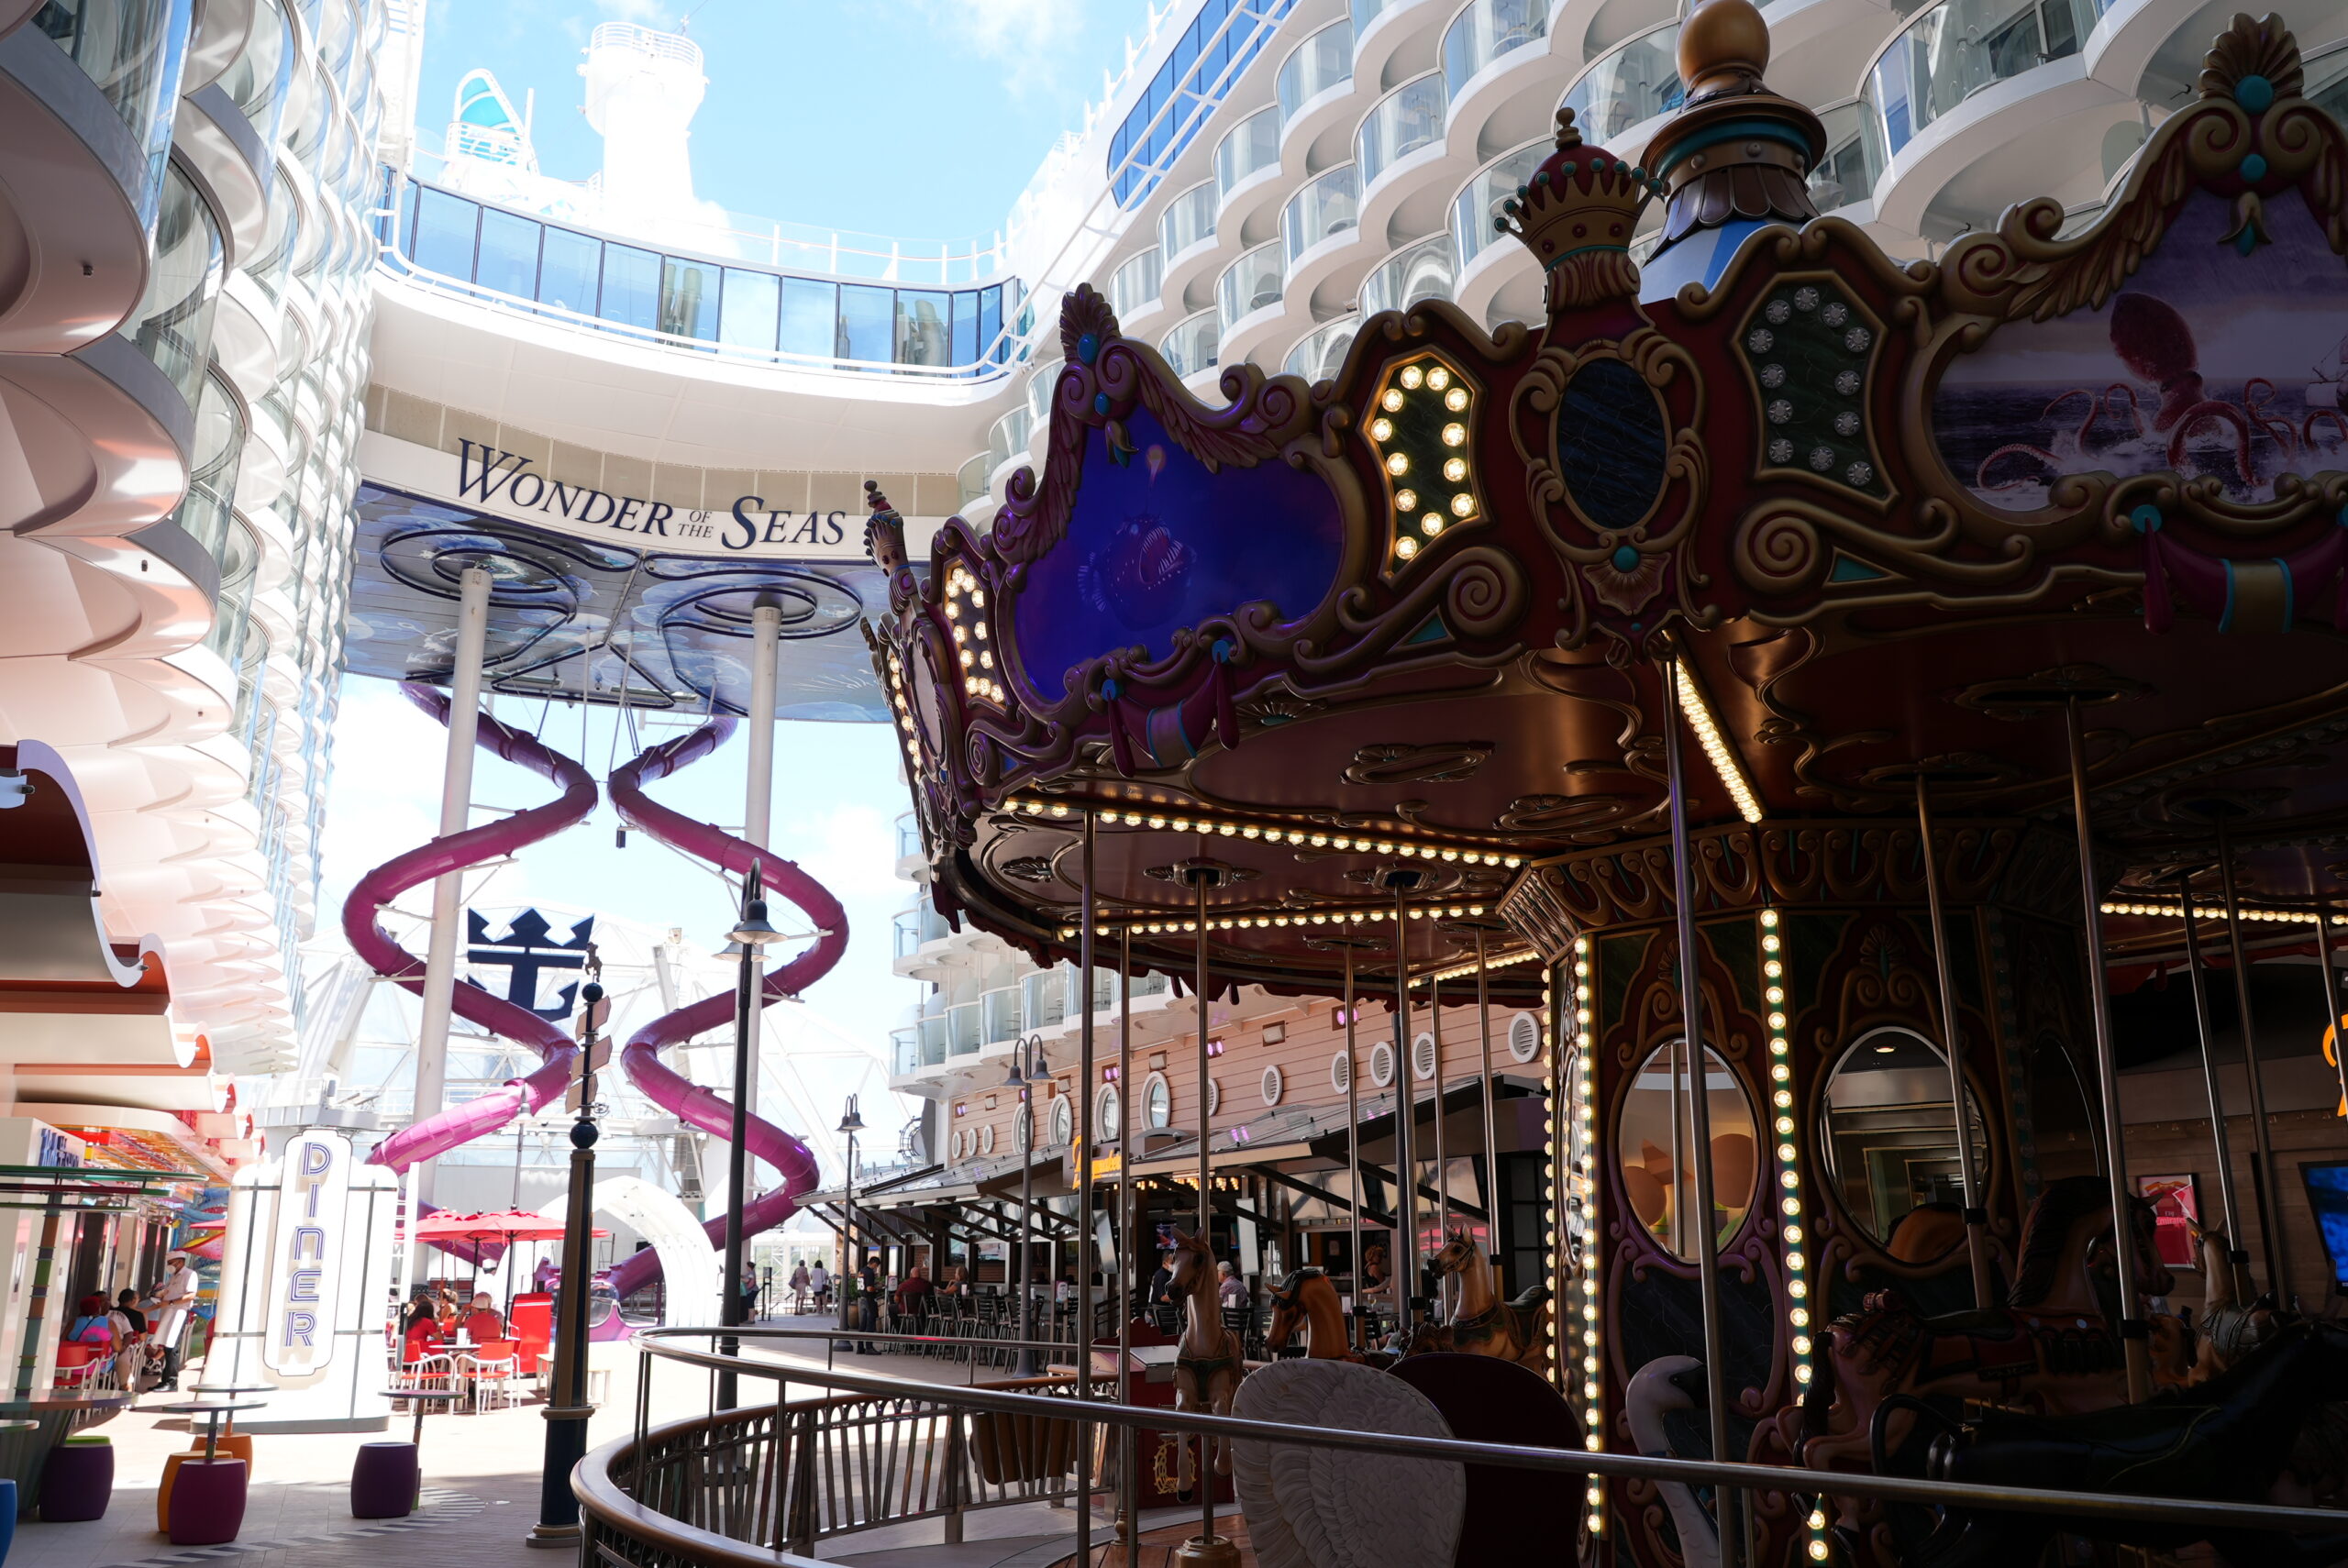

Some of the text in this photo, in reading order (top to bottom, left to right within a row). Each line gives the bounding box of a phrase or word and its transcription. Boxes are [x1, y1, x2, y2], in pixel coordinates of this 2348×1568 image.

[458, 437, 847, 550] WONDER OF THE SEAS
